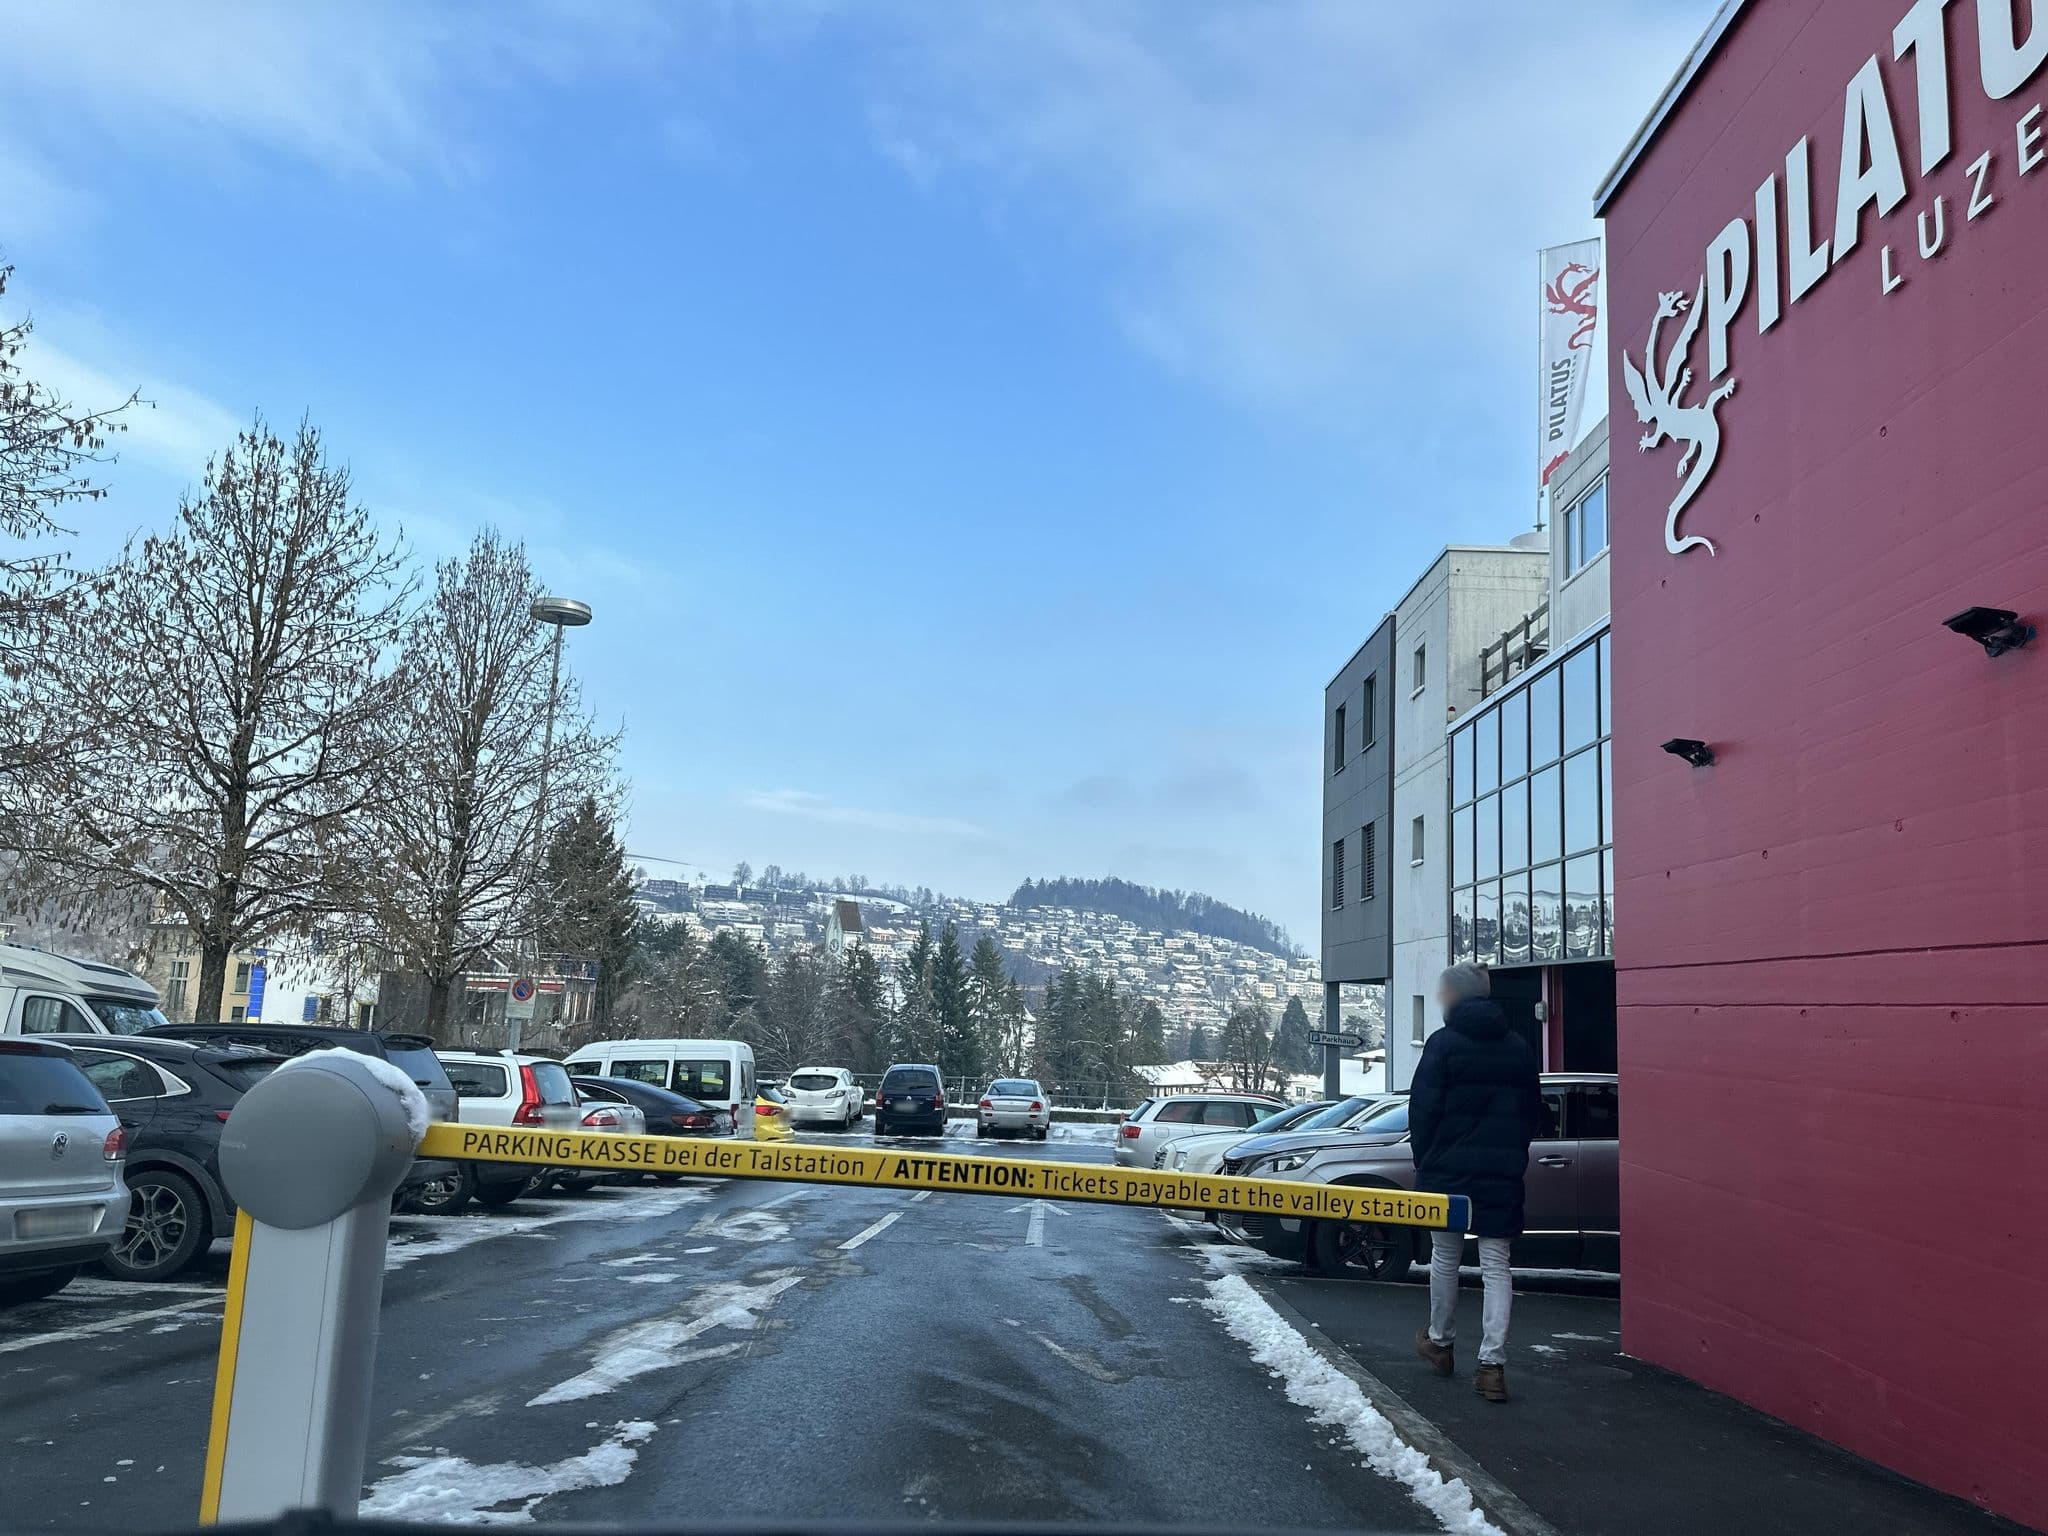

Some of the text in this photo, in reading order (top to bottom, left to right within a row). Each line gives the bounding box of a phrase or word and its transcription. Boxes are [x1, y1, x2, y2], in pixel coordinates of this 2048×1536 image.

[1881, 103, 2045, 296] LUZE
[1548, 358, 1571, 442] PILATUS
[1321, 1035, 1355, 1045] Parkhaus
[463, 1132, 1441, 1221] PARKING-KASSE bei der Talstation / ATTENTION: Tickets payable at the valley station
